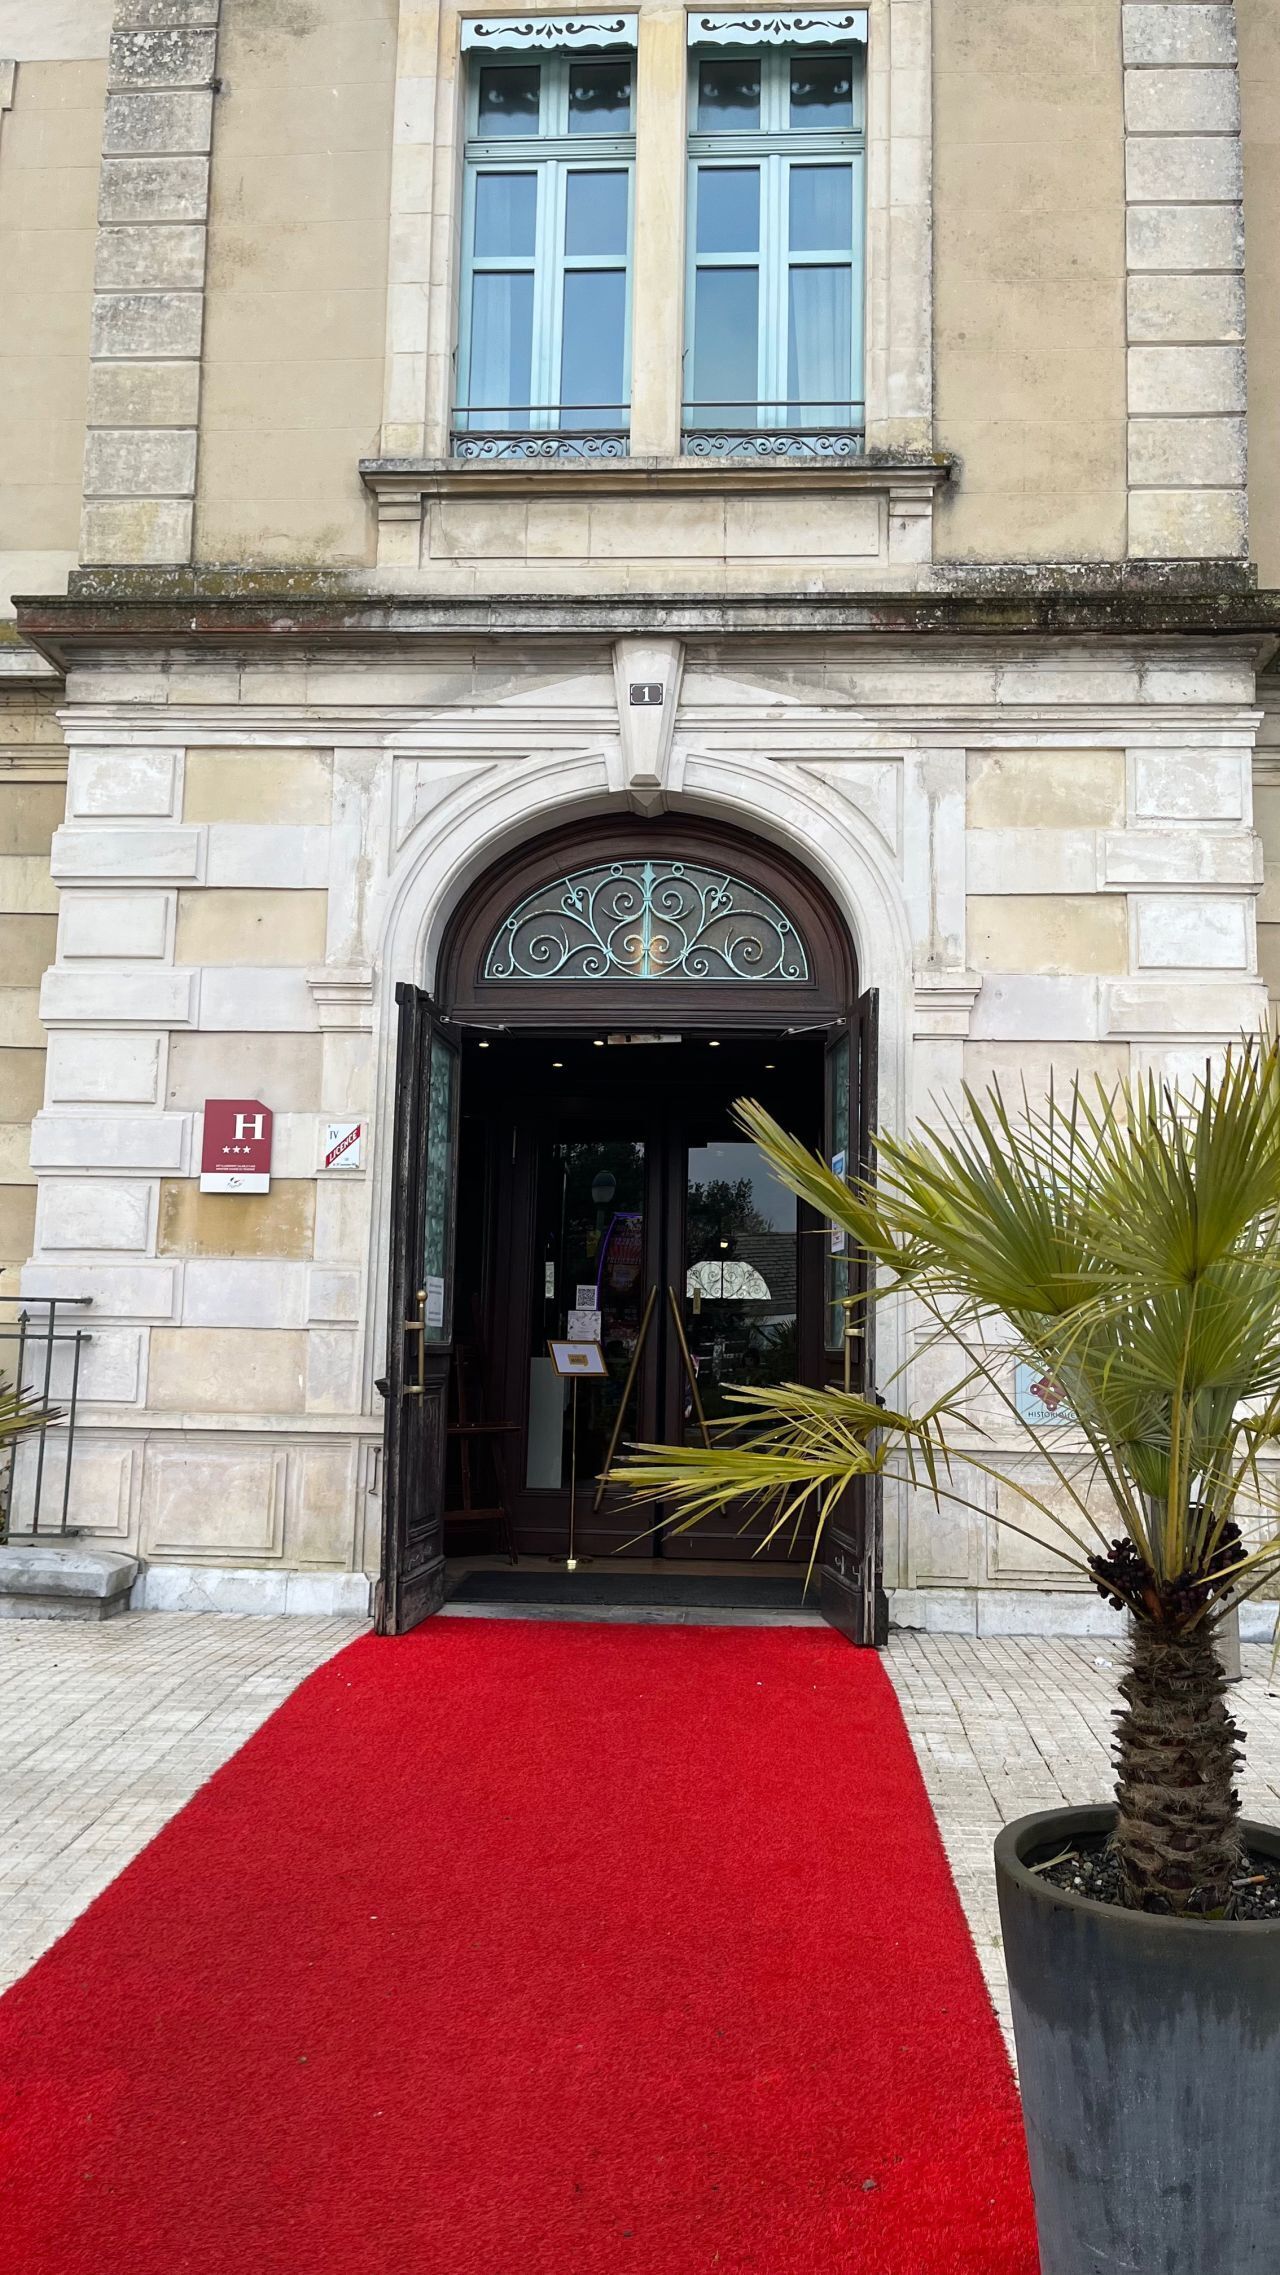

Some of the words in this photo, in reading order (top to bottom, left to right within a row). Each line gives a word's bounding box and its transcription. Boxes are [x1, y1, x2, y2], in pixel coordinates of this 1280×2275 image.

[642, 686, 650, 702] 1
[232, 1113, 267, 1140] H
[329, 1130, 339, 1140] IV
[328, 1129, 359, 1163] LICENCE
